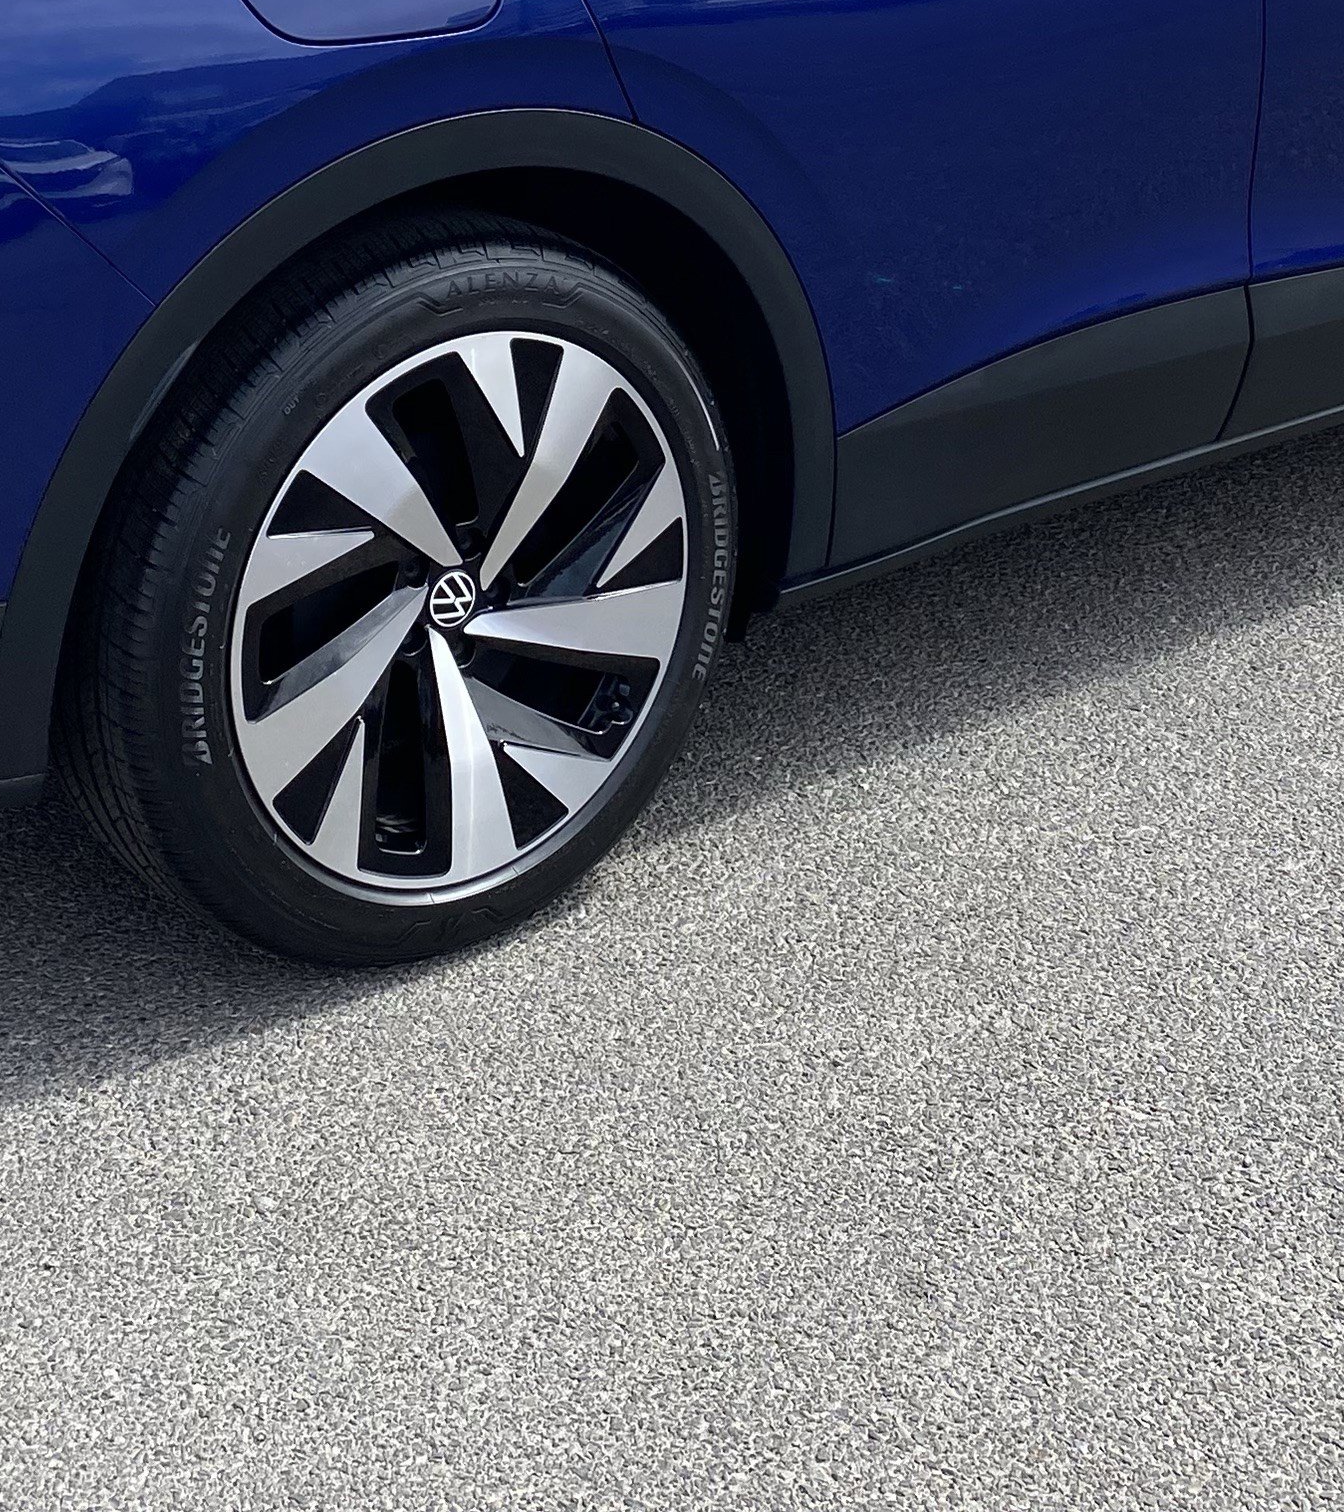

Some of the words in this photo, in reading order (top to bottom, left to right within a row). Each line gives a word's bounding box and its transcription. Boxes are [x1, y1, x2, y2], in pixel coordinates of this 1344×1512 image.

[448, 271, 560, 299] ALENZA
[181, 527, 232, 766] BRIDGESTONE
[692, 470, 731, 681] BRIDGESTONE
